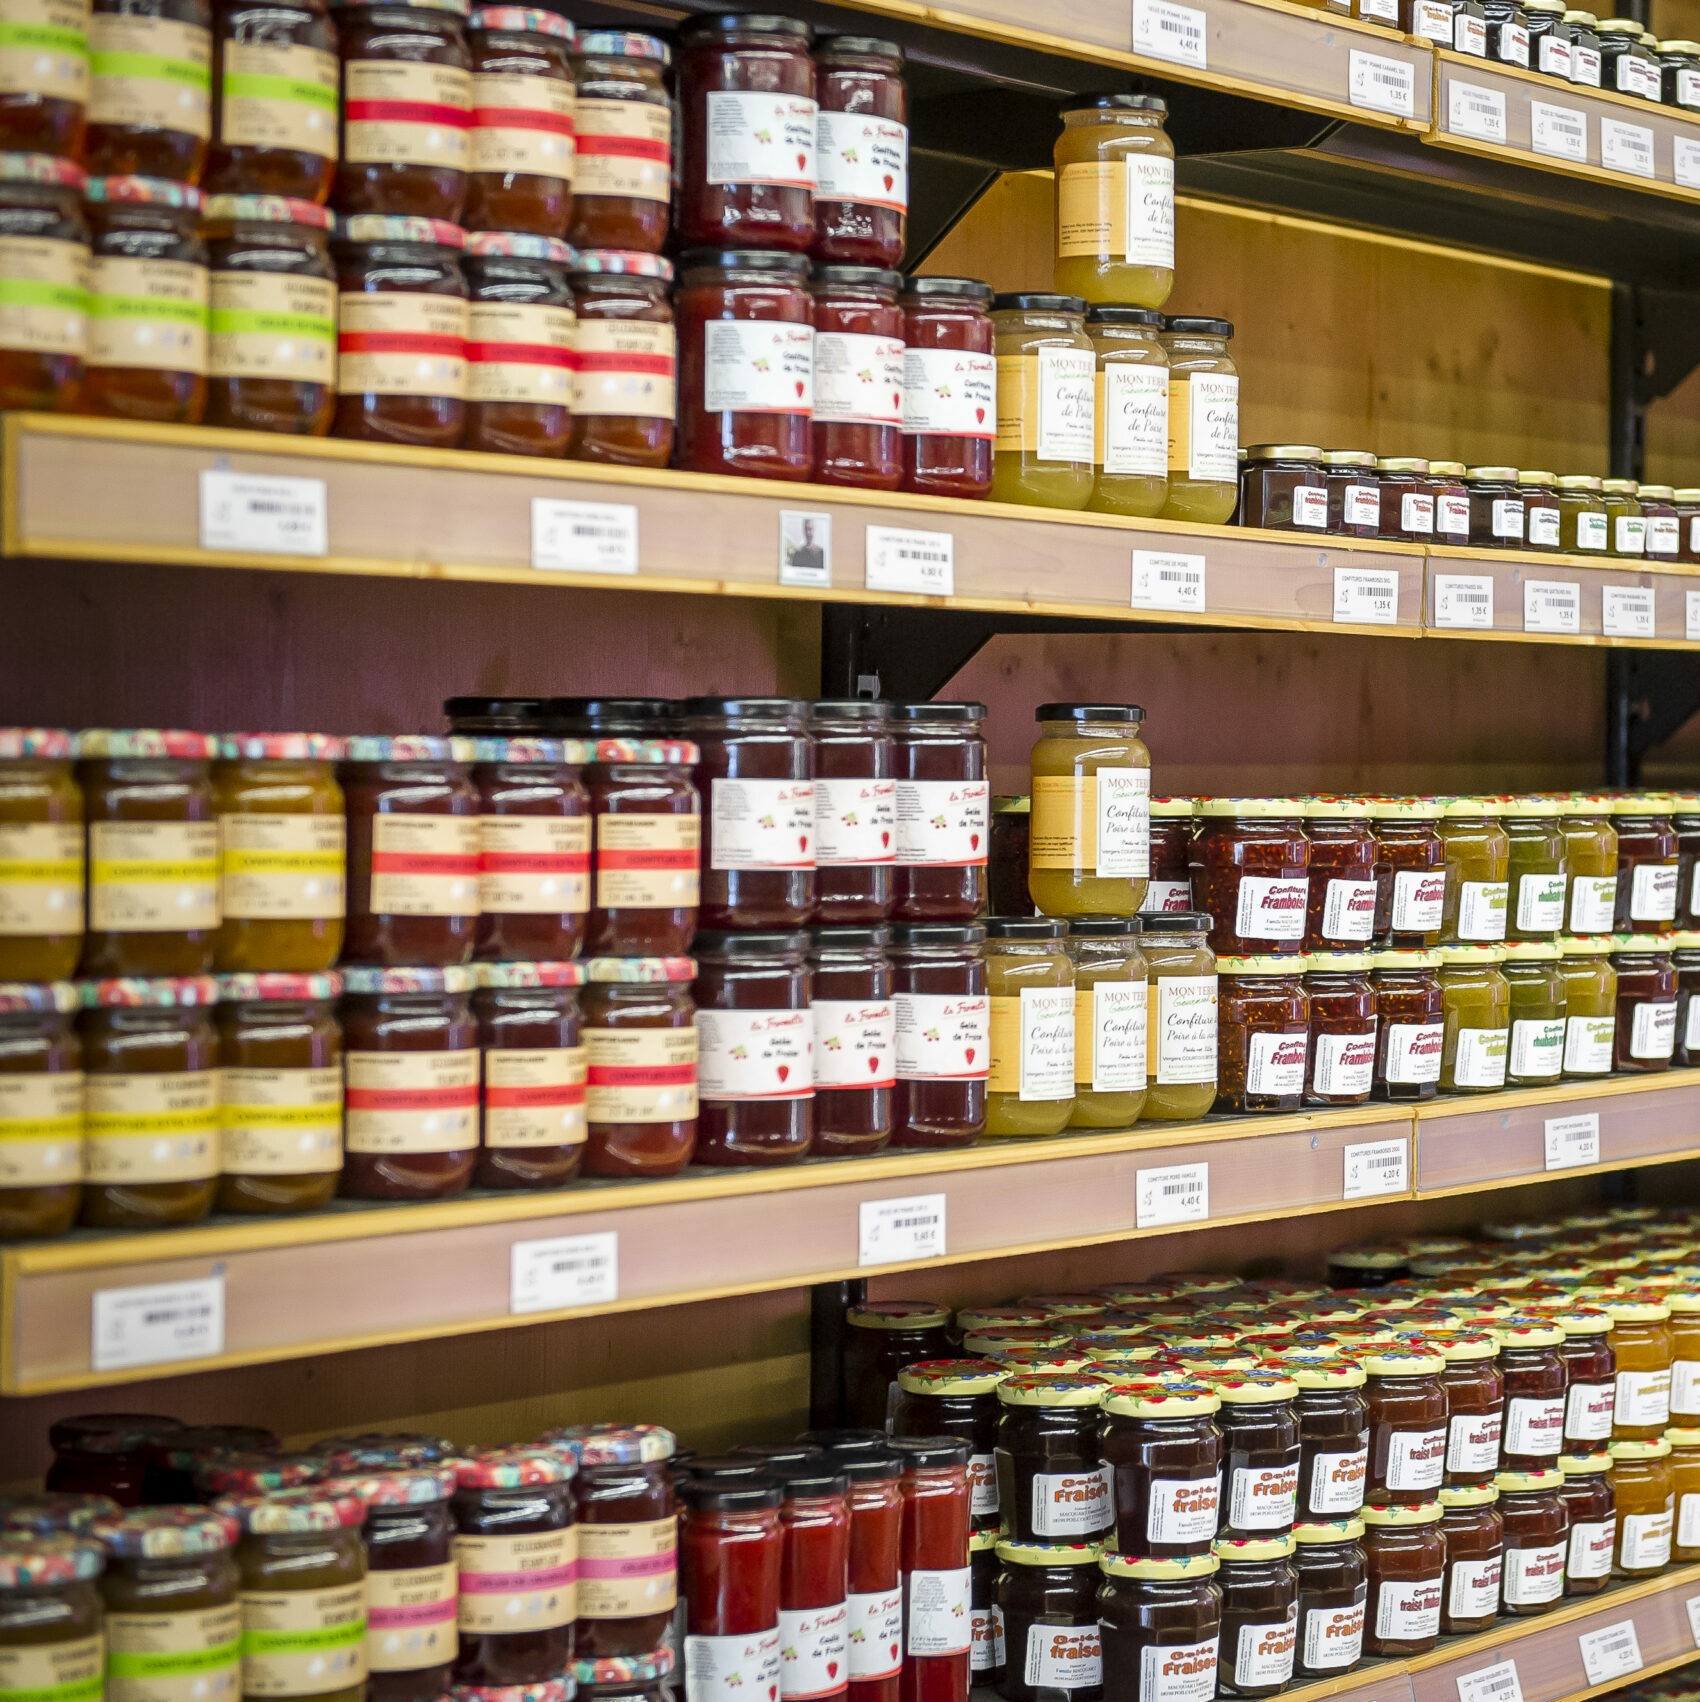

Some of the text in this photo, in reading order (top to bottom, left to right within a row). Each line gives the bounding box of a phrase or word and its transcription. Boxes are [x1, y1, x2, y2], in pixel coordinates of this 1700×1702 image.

[1390, 90, 1402, 100] 1,35
[1178, 587, 1191, 596] 4,40
[1374, 600, 1386, 609] 1,35
[1472, 606, 1482, 615] 1,35
[1108, 778, 1133, 789] MON
[1168, 986, 1194, 997] MON
[1167, 1030, 1189, 1041] Poire
[1383, 1169, 1394, 1179] 4,20
[1181, 1196, 1194, 1206] 4,40
[1261, 1469, 1296, 1481] Gelée
[1253, 1479, 1297, 1496] Fraises
[1170, 1647, 1214, 1660] Gelée
[1163, 1657, 1217, 1676] Fraises
